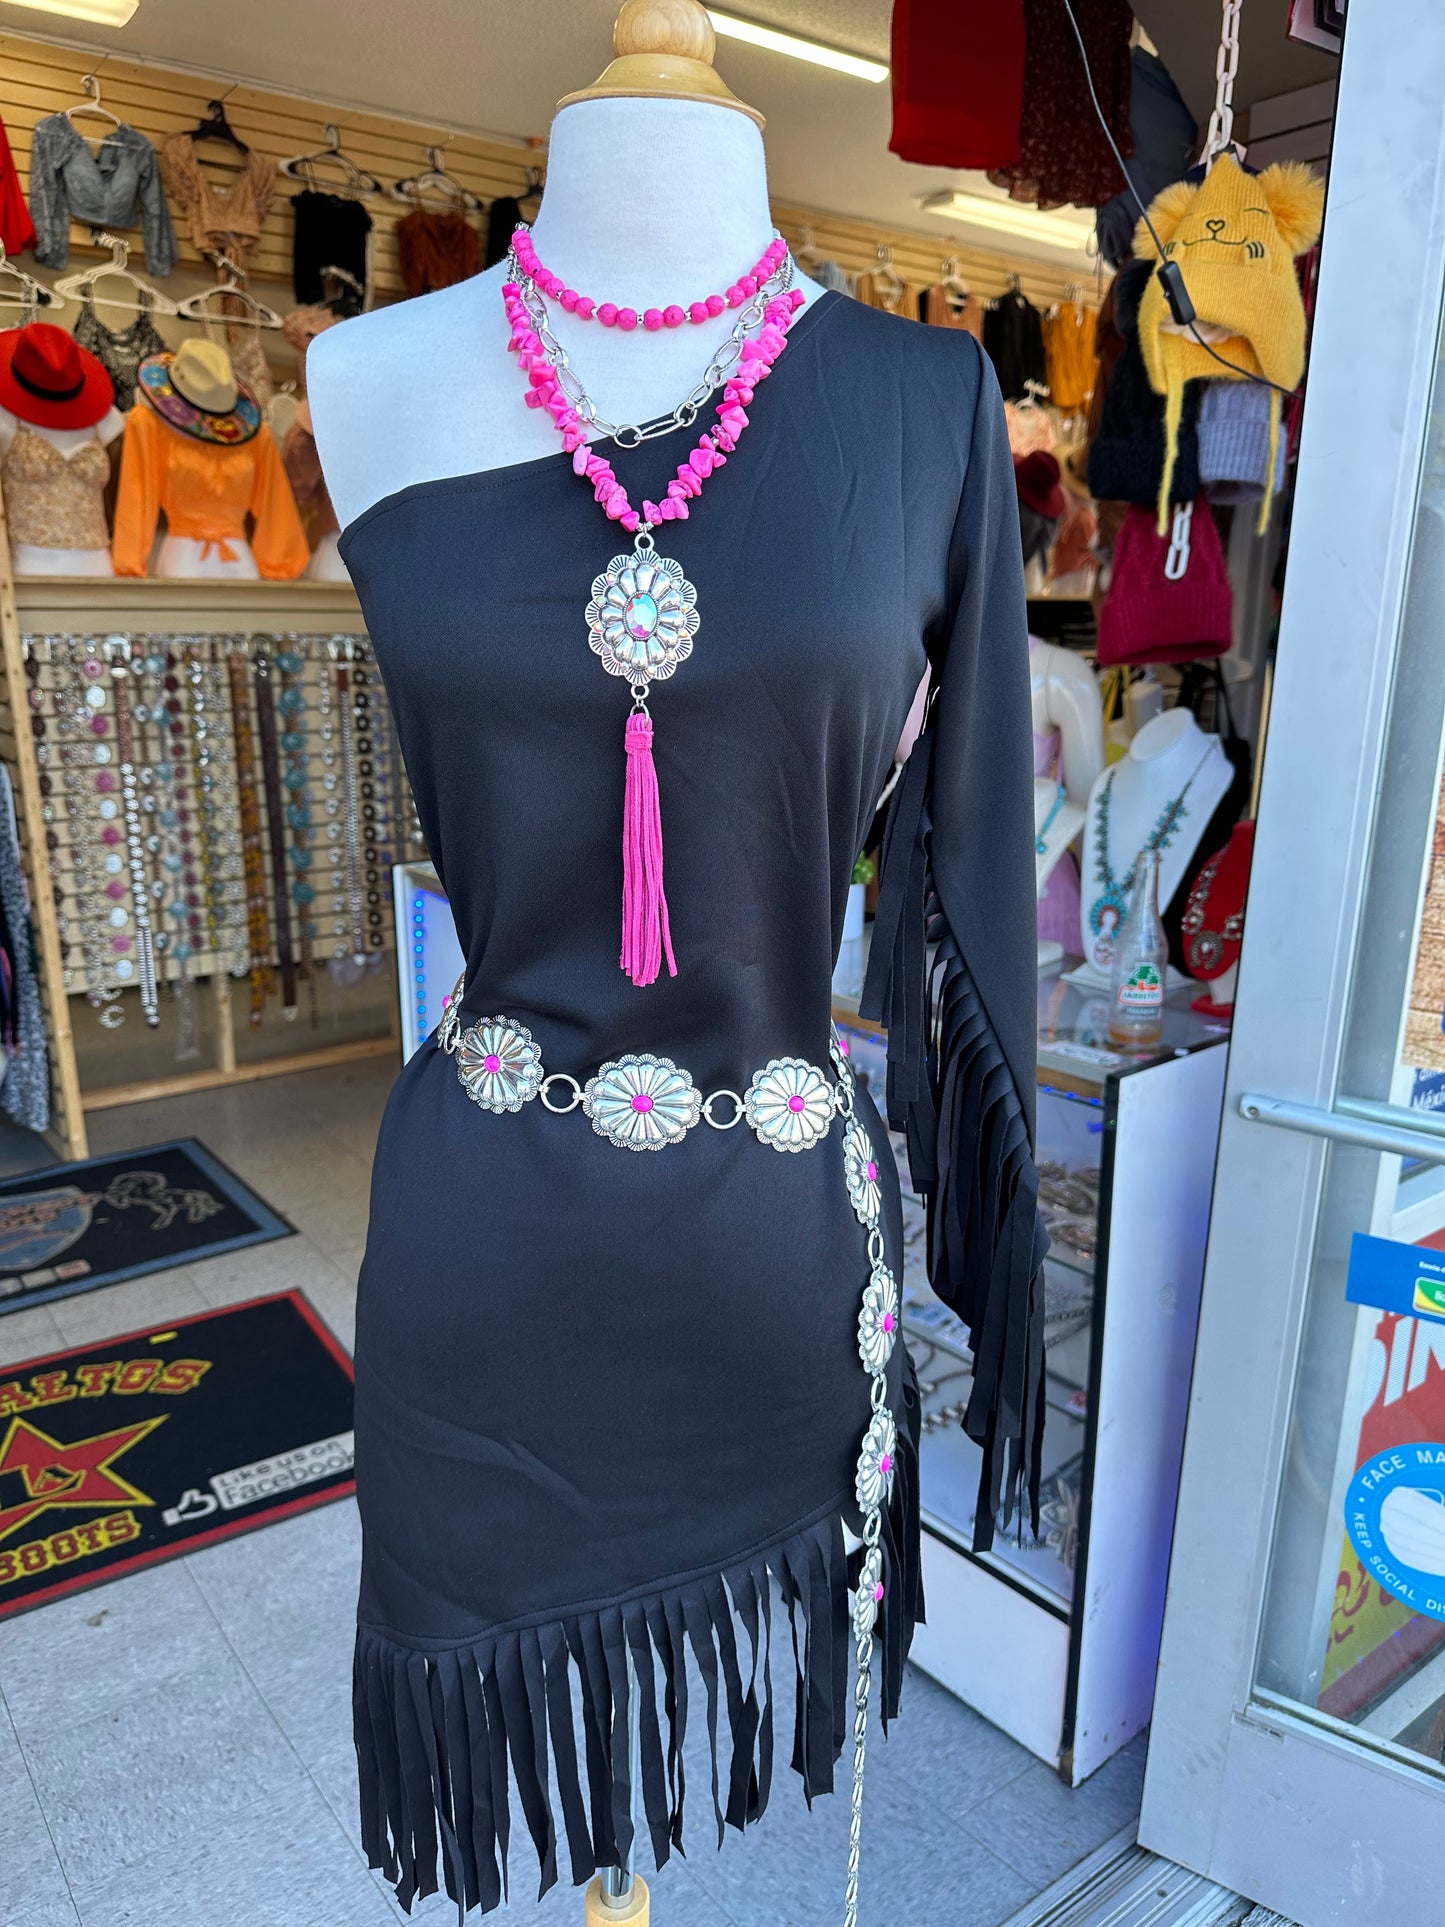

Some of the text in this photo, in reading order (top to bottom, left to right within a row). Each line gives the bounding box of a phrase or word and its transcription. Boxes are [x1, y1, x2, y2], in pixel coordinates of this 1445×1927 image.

[0, 1359, 212, 1418] ALTOS
[220, 1440, 341, 1487] Like us on
[1361, 1454, 1407, 1490] FACE
[0, 1509, 141, 1585] BOOTS
[1353, 1512, 1373, 1549] KEEP
[1368, 1555, 1417, 1601] SOCIAL
